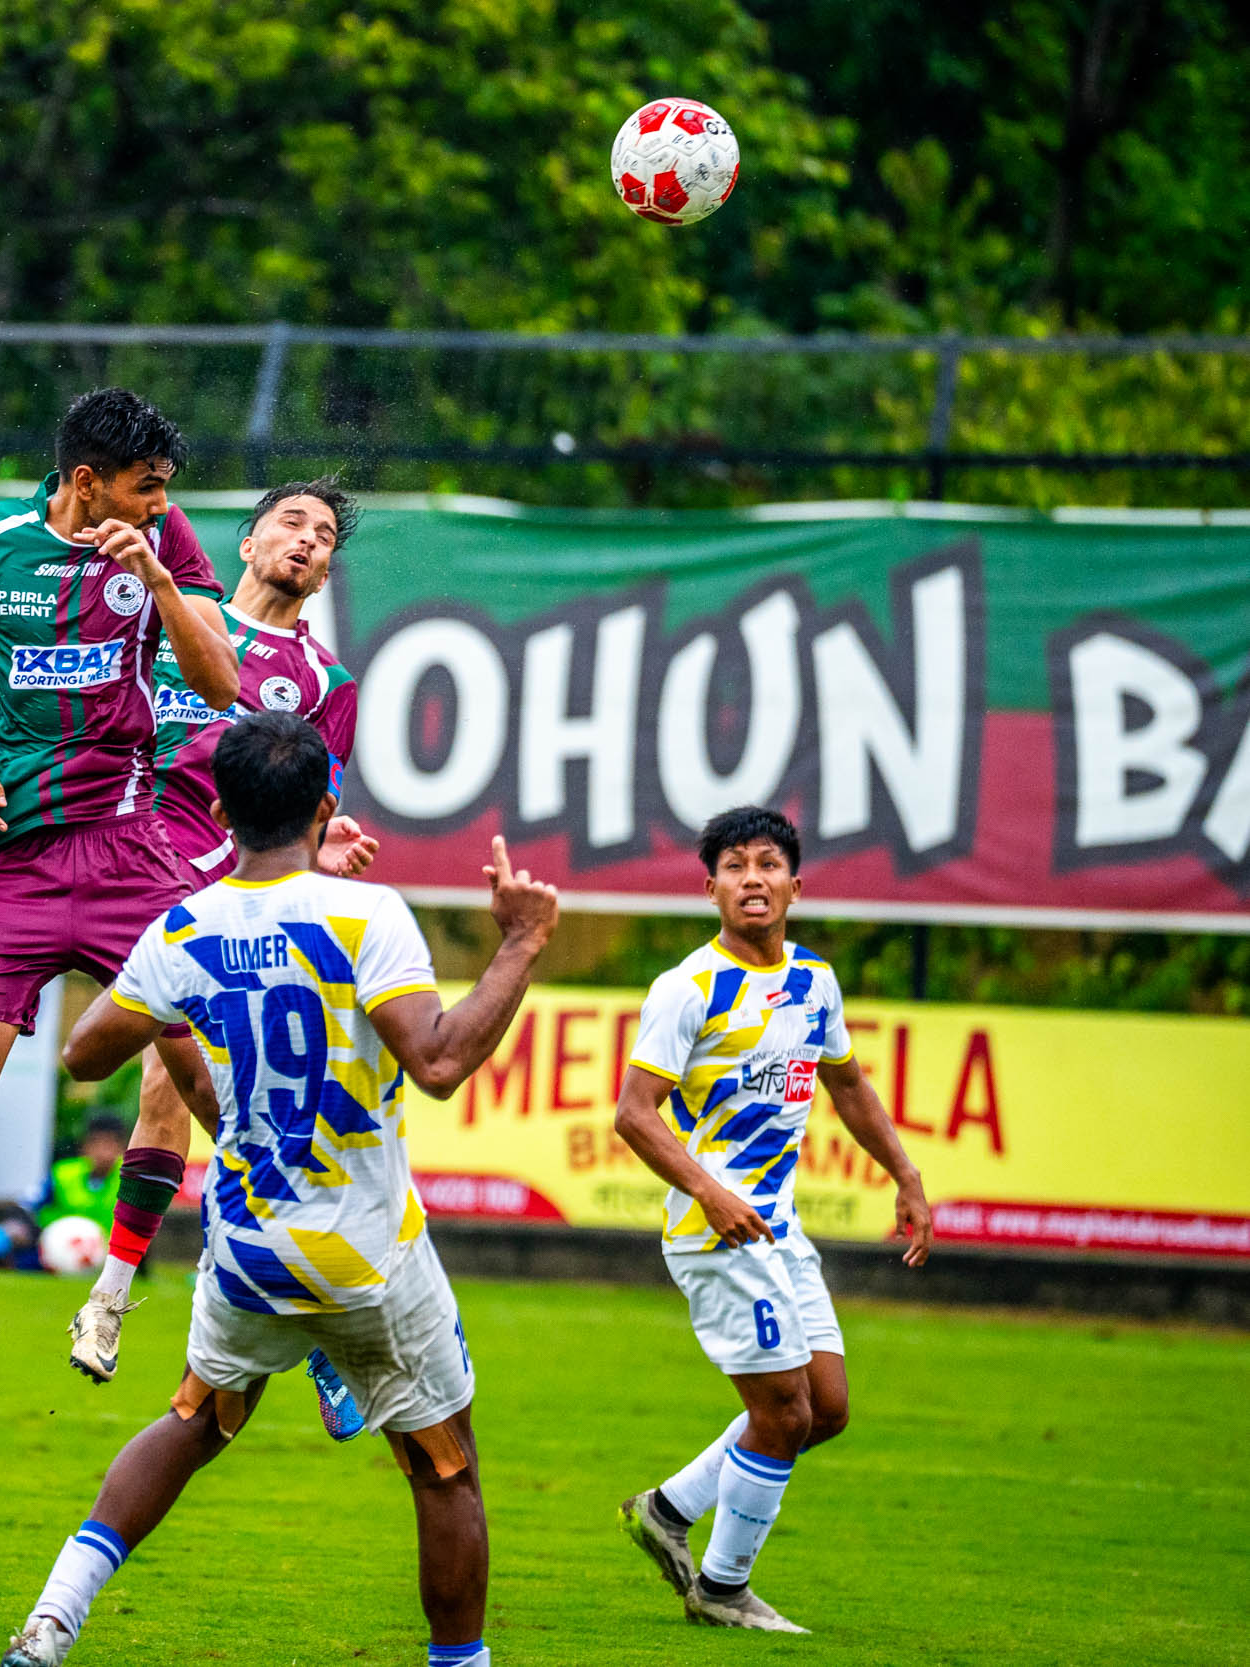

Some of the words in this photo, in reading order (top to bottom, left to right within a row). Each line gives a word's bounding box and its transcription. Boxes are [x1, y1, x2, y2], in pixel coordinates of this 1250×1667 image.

[10, 591, 57, 605] BIRLA
[13, 641, 124, 674] 1XBAT
[245, 640, 278, 659] TMT
[221, 934, 288, 974] UMER
[206, 984, 328, 1137] 19
[753, 1298, 781, 1350] 6
